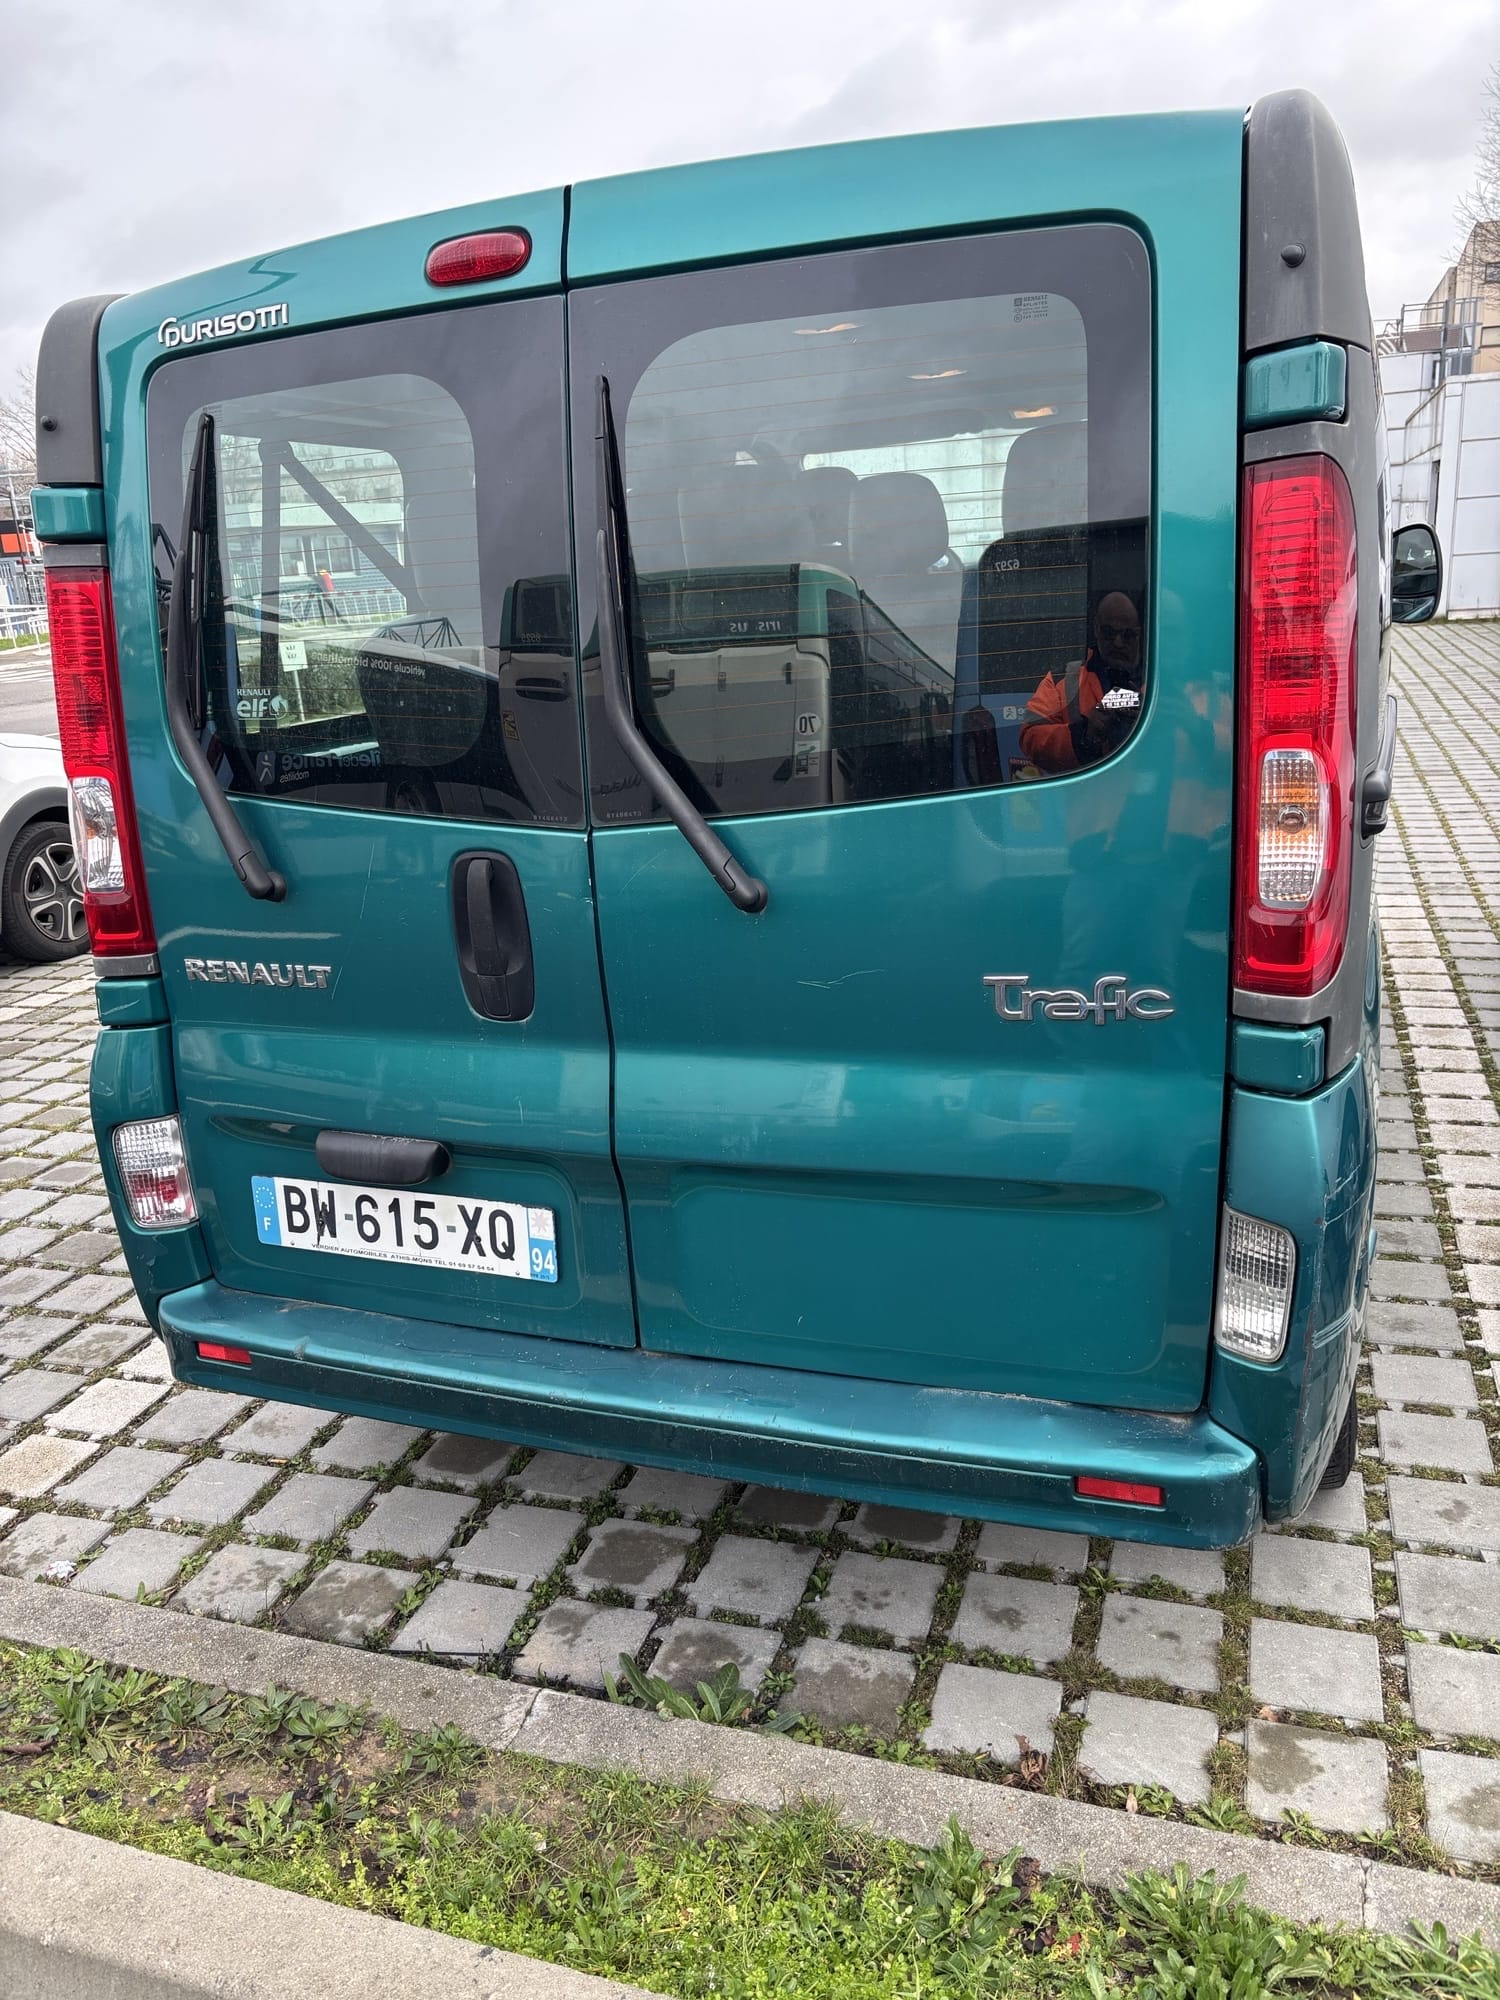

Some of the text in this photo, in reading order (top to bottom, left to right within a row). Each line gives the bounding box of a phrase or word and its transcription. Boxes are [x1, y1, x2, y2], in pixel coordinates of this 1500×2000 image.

[158, 303, 288, 347] DURISOTTI
[236, 688, 271, 696] RENAULT
[236, 698, 269, 718] elf
[183, 958, 332, 989] RENAULT
[983, 975, 1175, 1026] Trafic
[264, 1217, 272, 1231] F
[283, 1185, 515, 1261] BW-615-XQ
[341, 1248, 388, 1259] AUTOMOBILES
[391, 1254, 433, 1264] ATHIS-MONS
[531, 1247, 556, 1274] 94
